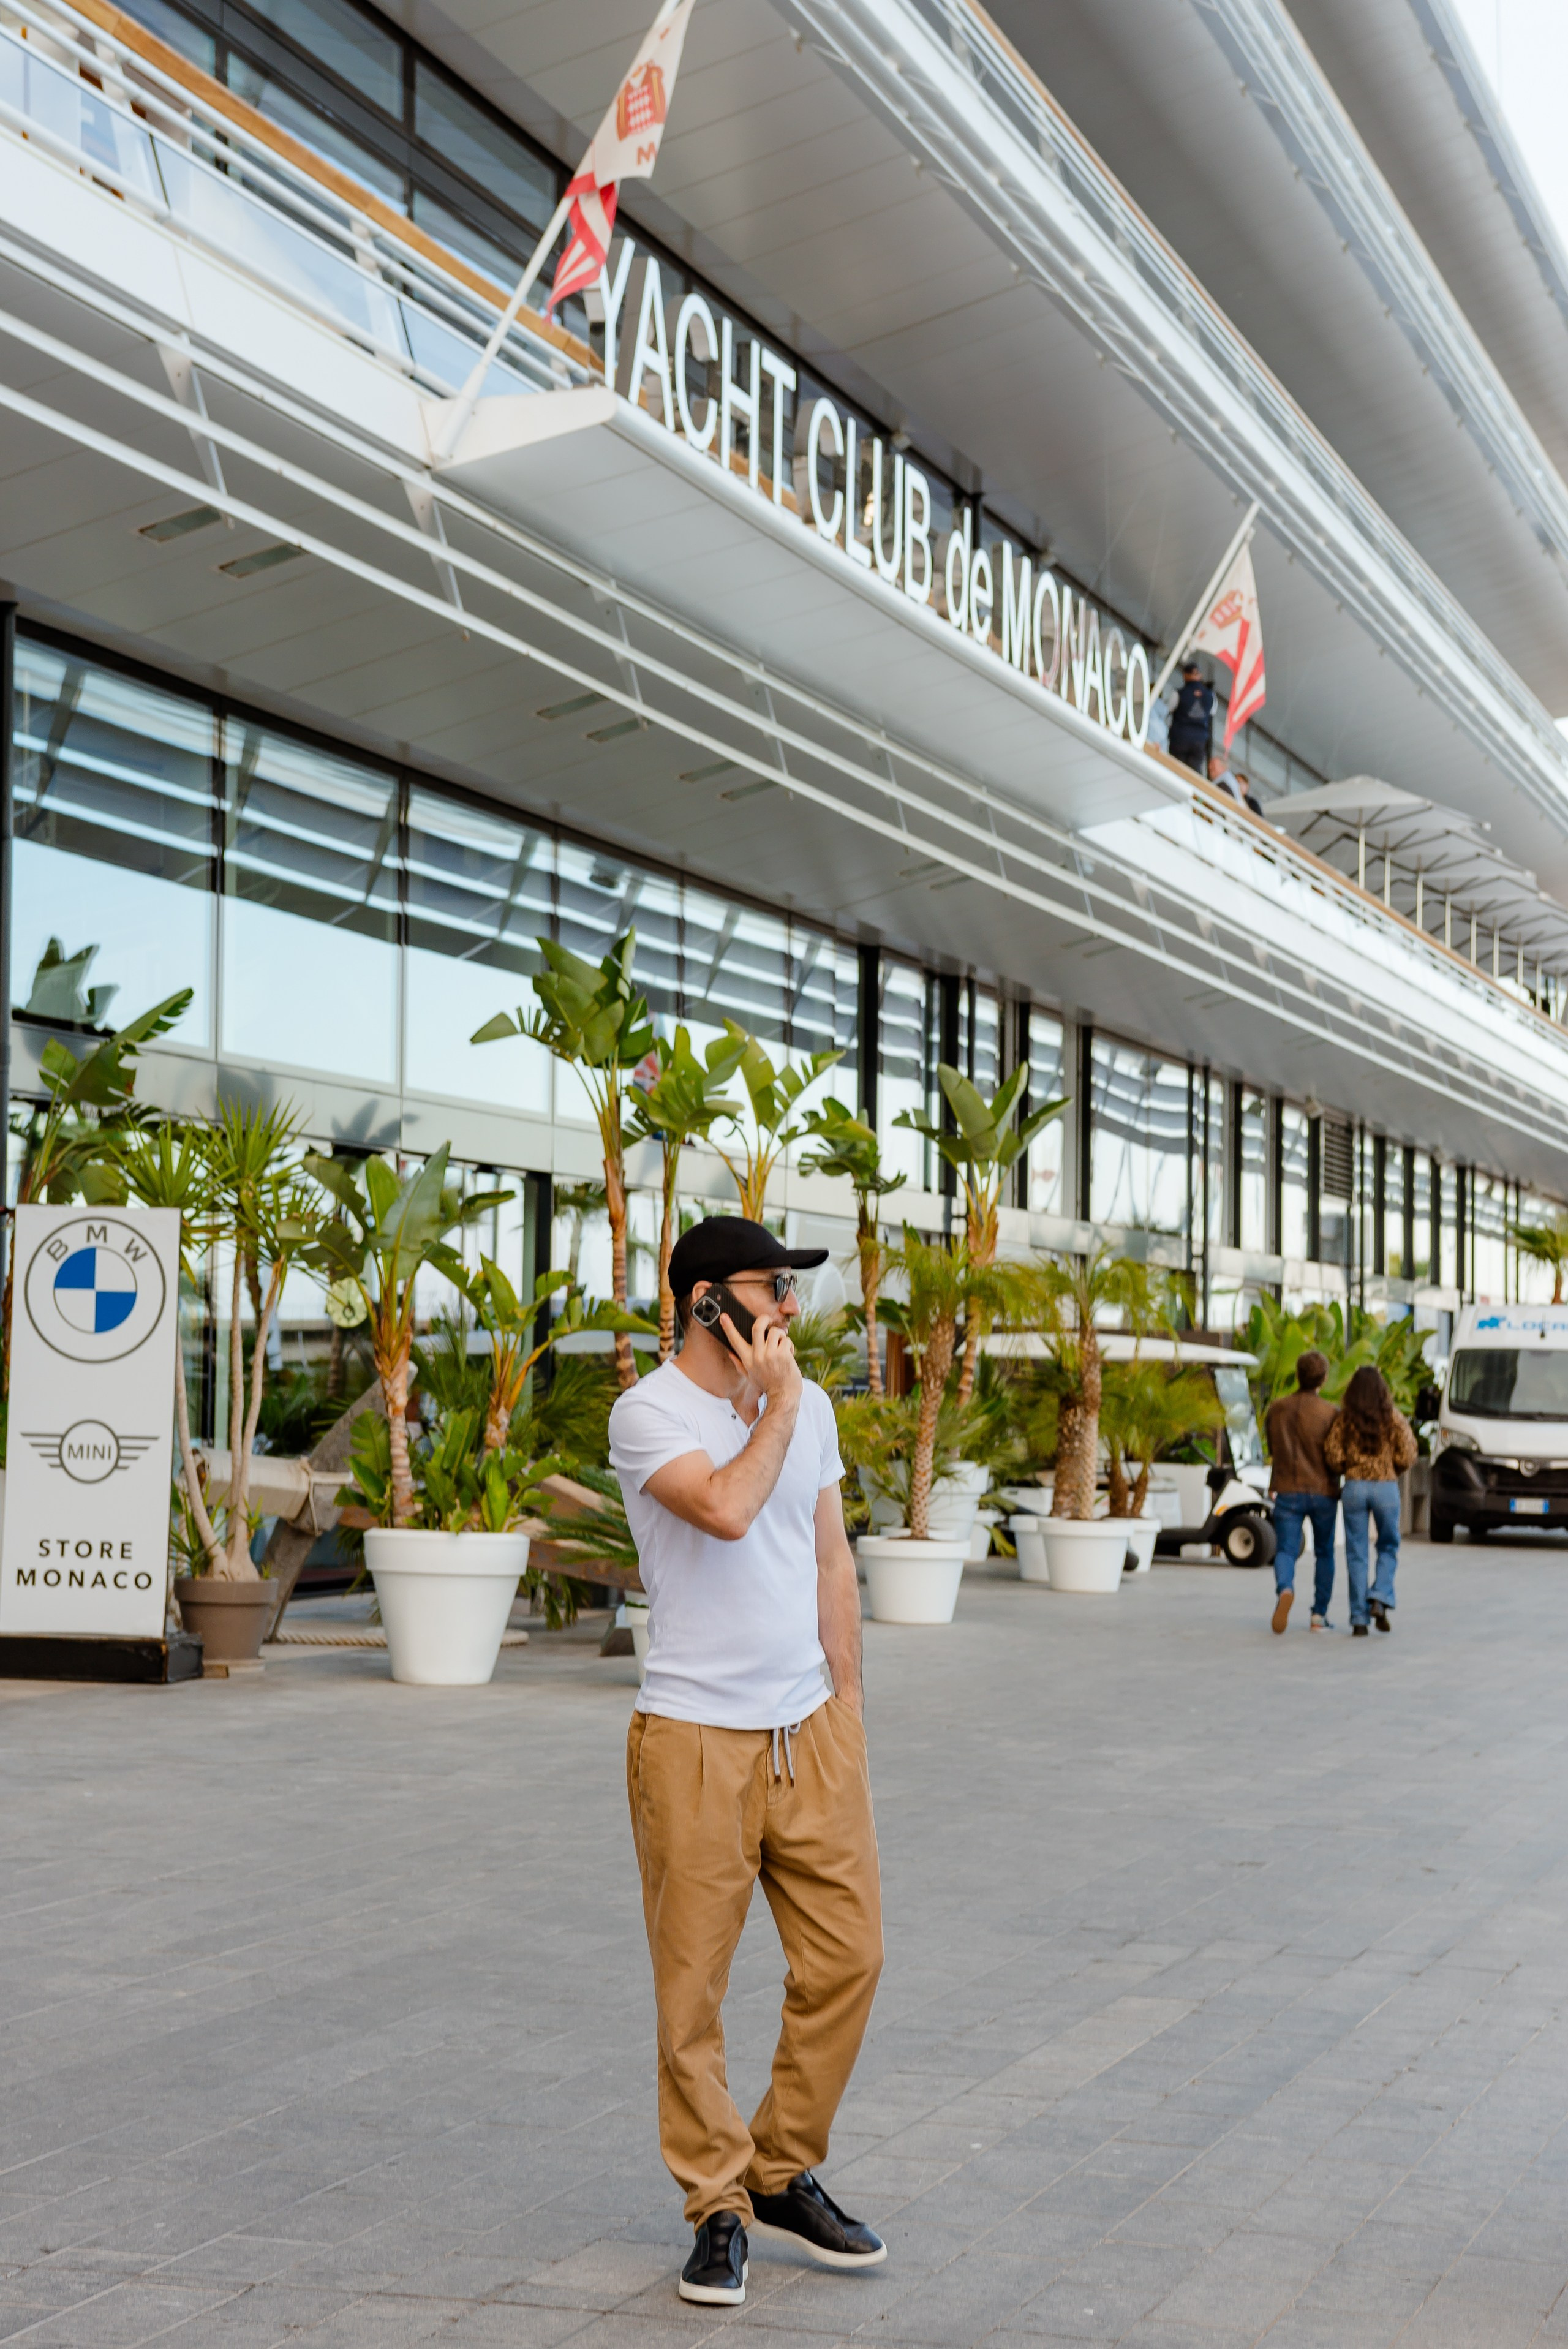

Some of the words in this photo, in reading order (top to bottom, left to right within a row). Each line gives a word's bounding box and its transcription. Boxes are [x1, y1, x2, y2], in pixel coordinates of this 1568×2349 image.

[600, 236, 796, 506] YACHT
[808, 397, 932, 605] CLUB
[945, 507, 993, 646] de
[1001, 539, 1151, 753] MONACO
[46, 1224, 149, 1264] BMW
[67, 1443, 113, 1461] MINI
[38, 1538, 134, 1560] STORE
[15, 1567, 153, 1591] MONACO
